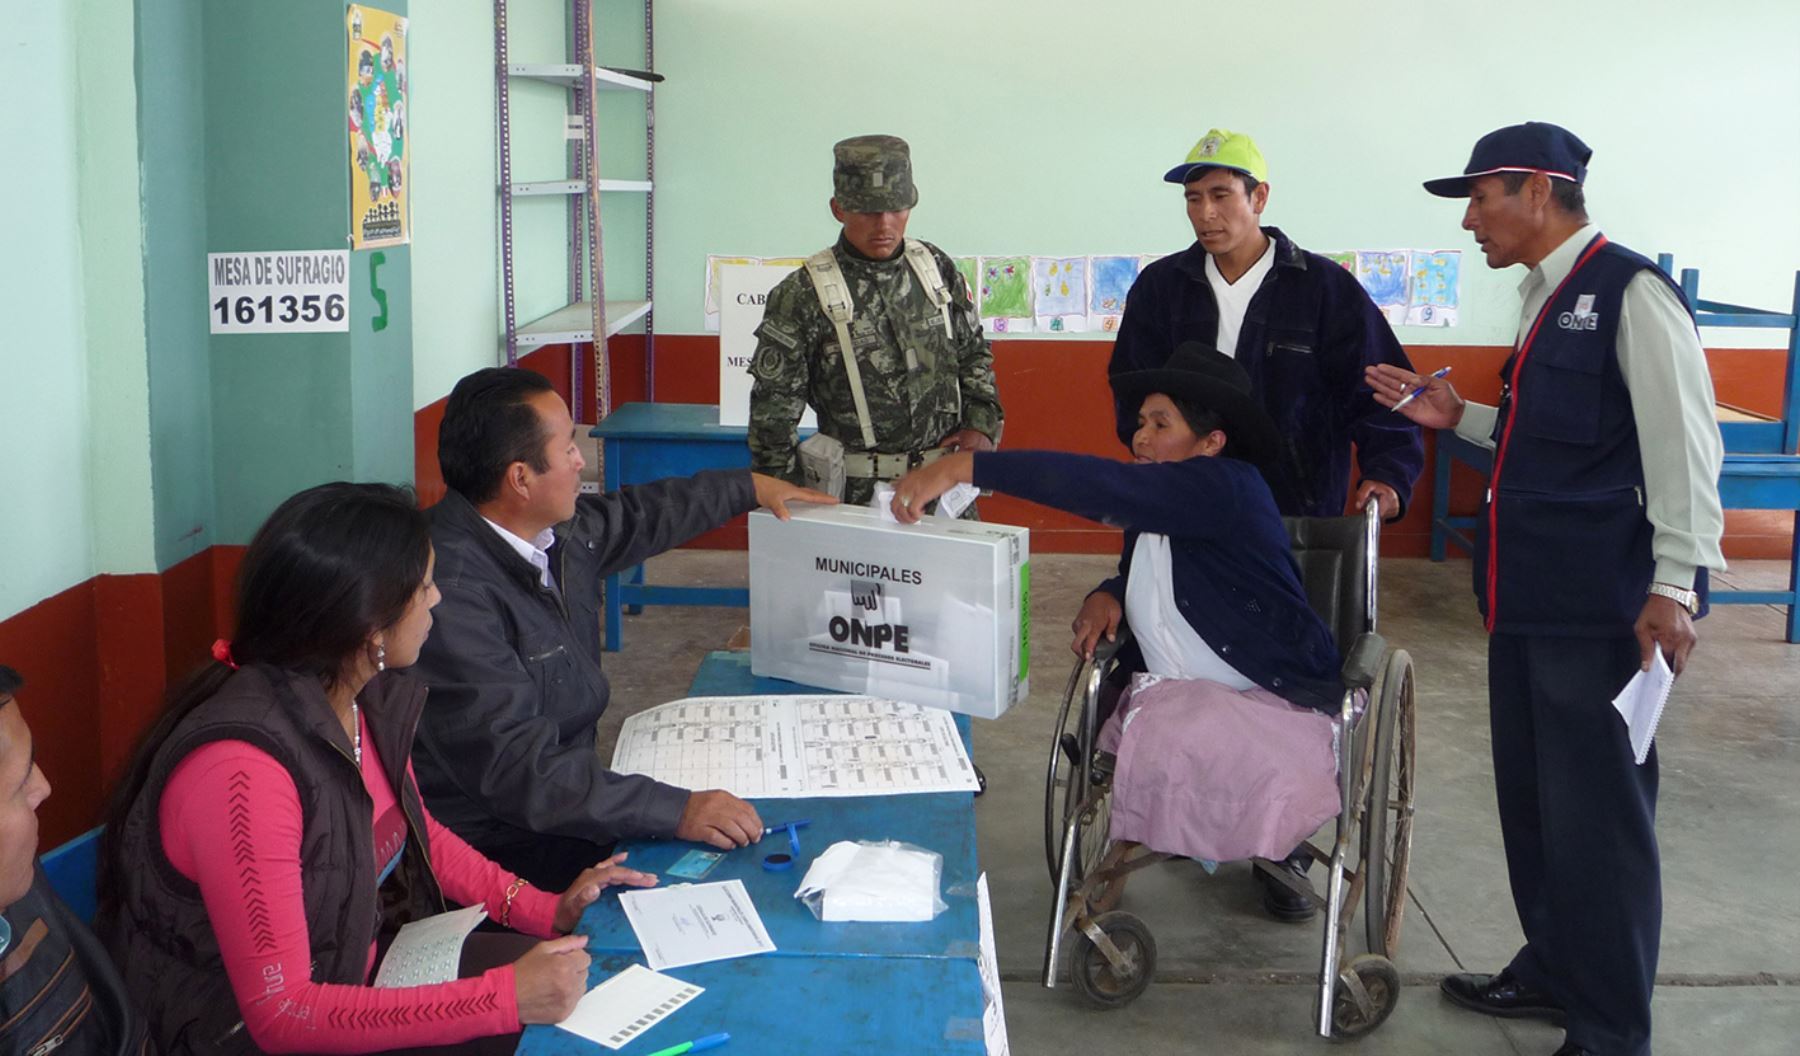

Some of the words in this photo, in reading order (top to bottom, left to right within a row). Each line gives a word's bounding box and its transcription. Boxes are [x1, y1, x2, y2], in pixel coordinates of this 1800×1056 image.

[214, 257, 251, 286] MESA
[254, 257, 272, 285] DE
[276, 255, 345, 285] SUFRAGIO
[214, 294, 345, 324] 161356
[736, 293, 767, 306] CAB
[1423, 307, 1433, 321] 9
[815, 557, 922, 585] MUNICIPALES
[829, 616, 909, 653] ONPE
